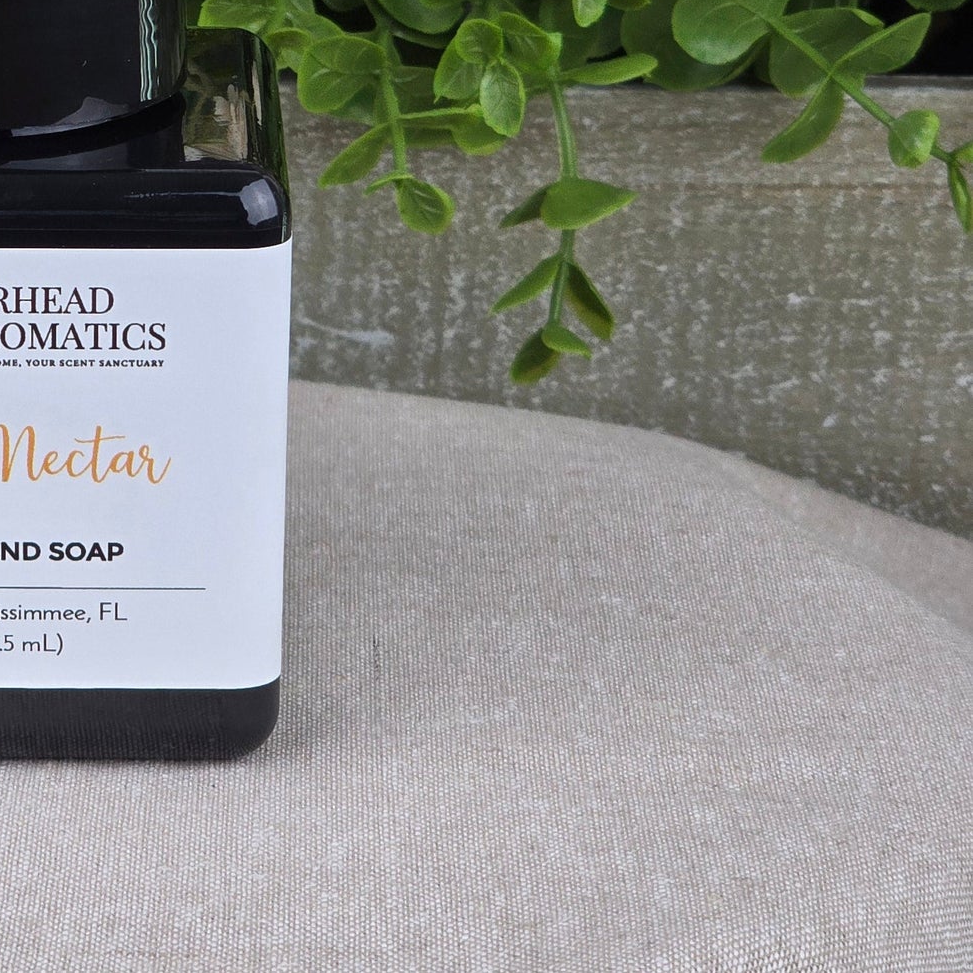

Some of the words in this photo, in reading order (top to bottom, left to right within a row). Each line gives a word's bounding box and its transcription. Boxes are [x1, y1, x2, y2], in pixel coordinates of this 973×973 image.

[25, 359, 56, 368] YOUR
[59, 359, 96, 368] SCENT
[99, 359, 165, 368] SANCTUARY
[48, 541, 124, 562] SOAP
[99, 602, 128, 622] FL
[21, 633, 64, 656] mL)
